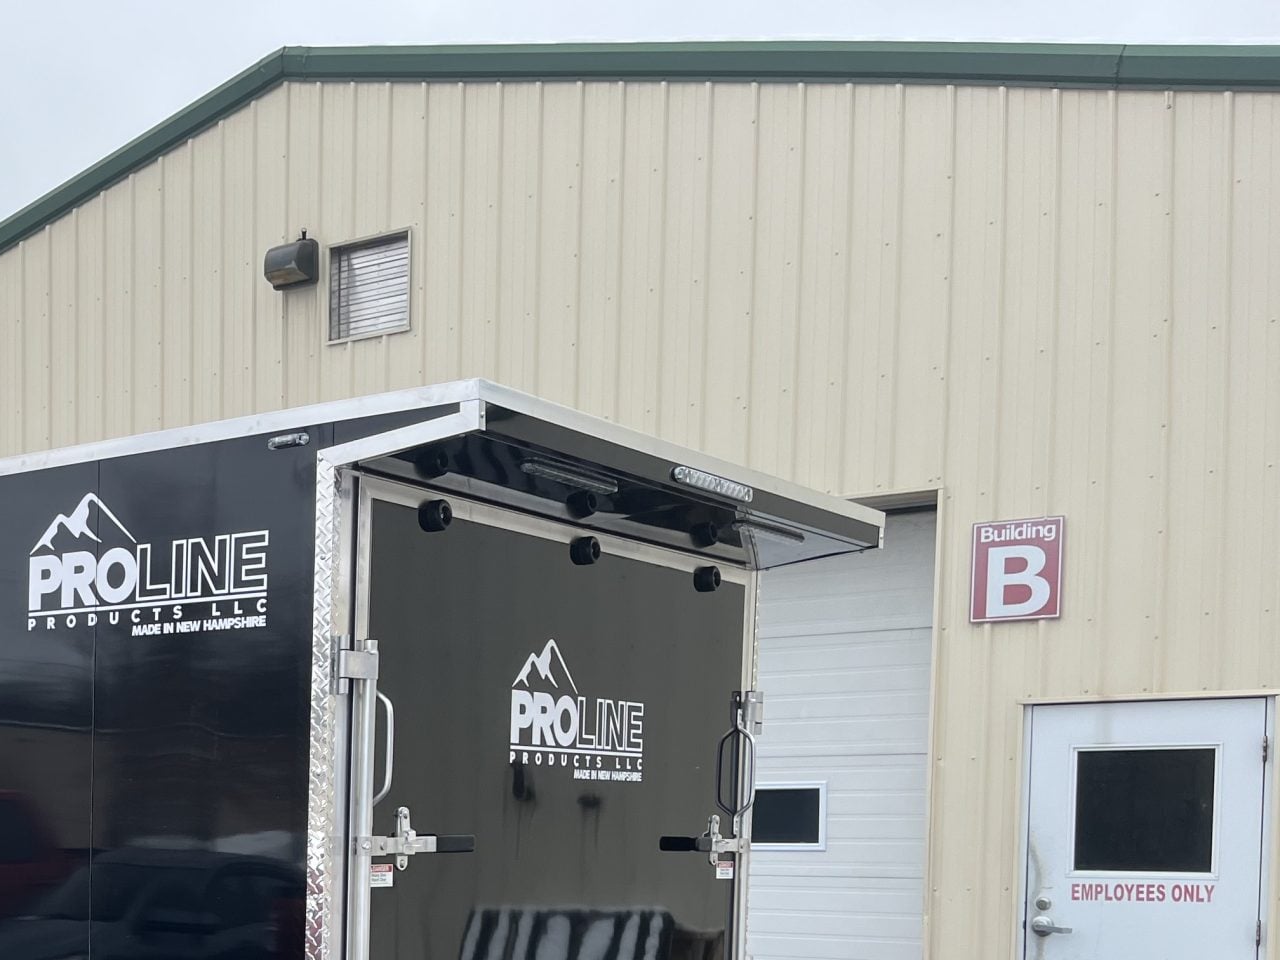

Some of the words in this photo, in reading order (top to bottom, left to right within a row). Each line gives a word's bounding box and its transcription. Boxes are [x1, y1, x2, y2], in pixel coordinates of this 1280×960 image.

[980, 523, 1057, 543] Building
[27, 529, 270, 612] PROLINE
[985, 544, 1051, 618] B
[27, 605, 184, 632] PRODUCTS
[211, 598, 268, 617] LLC
[131, 622, 163, 637] MADE
[163, 621, 175, 634] IN
[175, 618, 202, 634] NEW
[202, 614, 268, 632] HAMPSHIRE
[509, 689, 645, 752] PROLINE
[509, 750, 602, 769] PRODUCTS
[614, 757, 644, 771] LLC
[573, 768, 591, 780] MADE
[590, 769, 598, 780] IN
[597, 769, 612, 781] NEW
[610, 770, 643, 782] HAMPSHIRE
[1071, 883, 1166, 902] EMPLOYEES
[1171, 884, 1215, 903] ONLY
